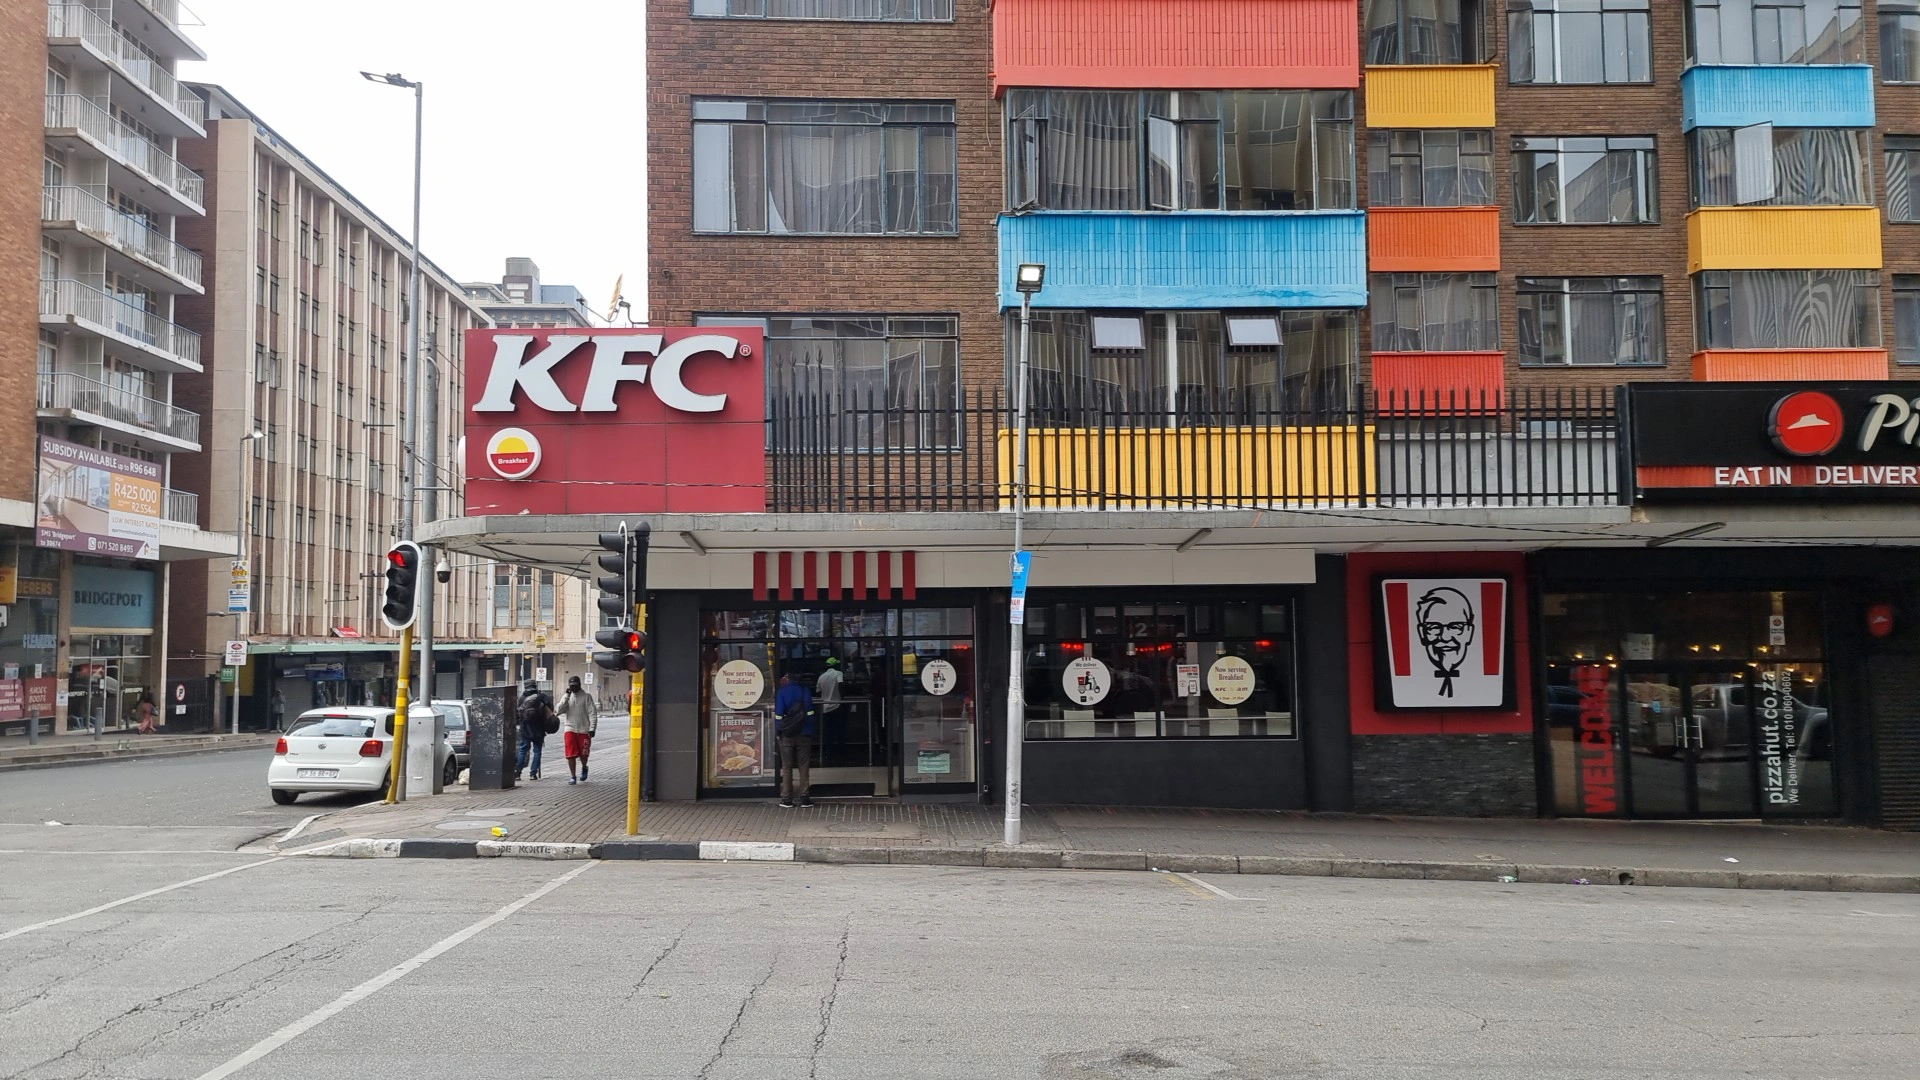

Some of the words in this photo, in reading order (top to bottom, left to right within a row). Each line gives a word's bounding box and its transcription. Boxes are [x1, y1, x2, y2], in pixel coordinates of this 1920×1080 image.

[471, 334, 739, 413] KFC
[1859, 393, 1920, 452] Pi
[43, 441, 78, 459] SUBSIDY
[78, 450, 118, 469] AVAILABLE
[130, 462, 143, 474] R96
[143, 466, 157, 477] 648
[498, 457, 528, 465] Breakfast
[1714, 467, 1762, 485] EAT
[1770, 467, 1792, 485] IN
[1815, 466, 1920, 485] DELIVER
[114, 482, 138, 500] R425
[139, 487, 157, 504] 000
[97, 541, 108, 550] 071
[108, 542, 119, 552] 520
[119, 543, 134, 553] 8495
[74, 590, 143, 607] BRIDGEPORT
[1784, 714, 1794, 731] 010
[1761, 671, 1788, 804] pizzahut.co.za
[1785, 732, 1796, 749] Tel:
[1787, 753, 1798, 786] Deliver
[1789, 789, 1800, 804] We
[498, 845, 512, 853] DE
[518, 845, 551, 854] KORTE
[563, 846, 576, 854] ST
